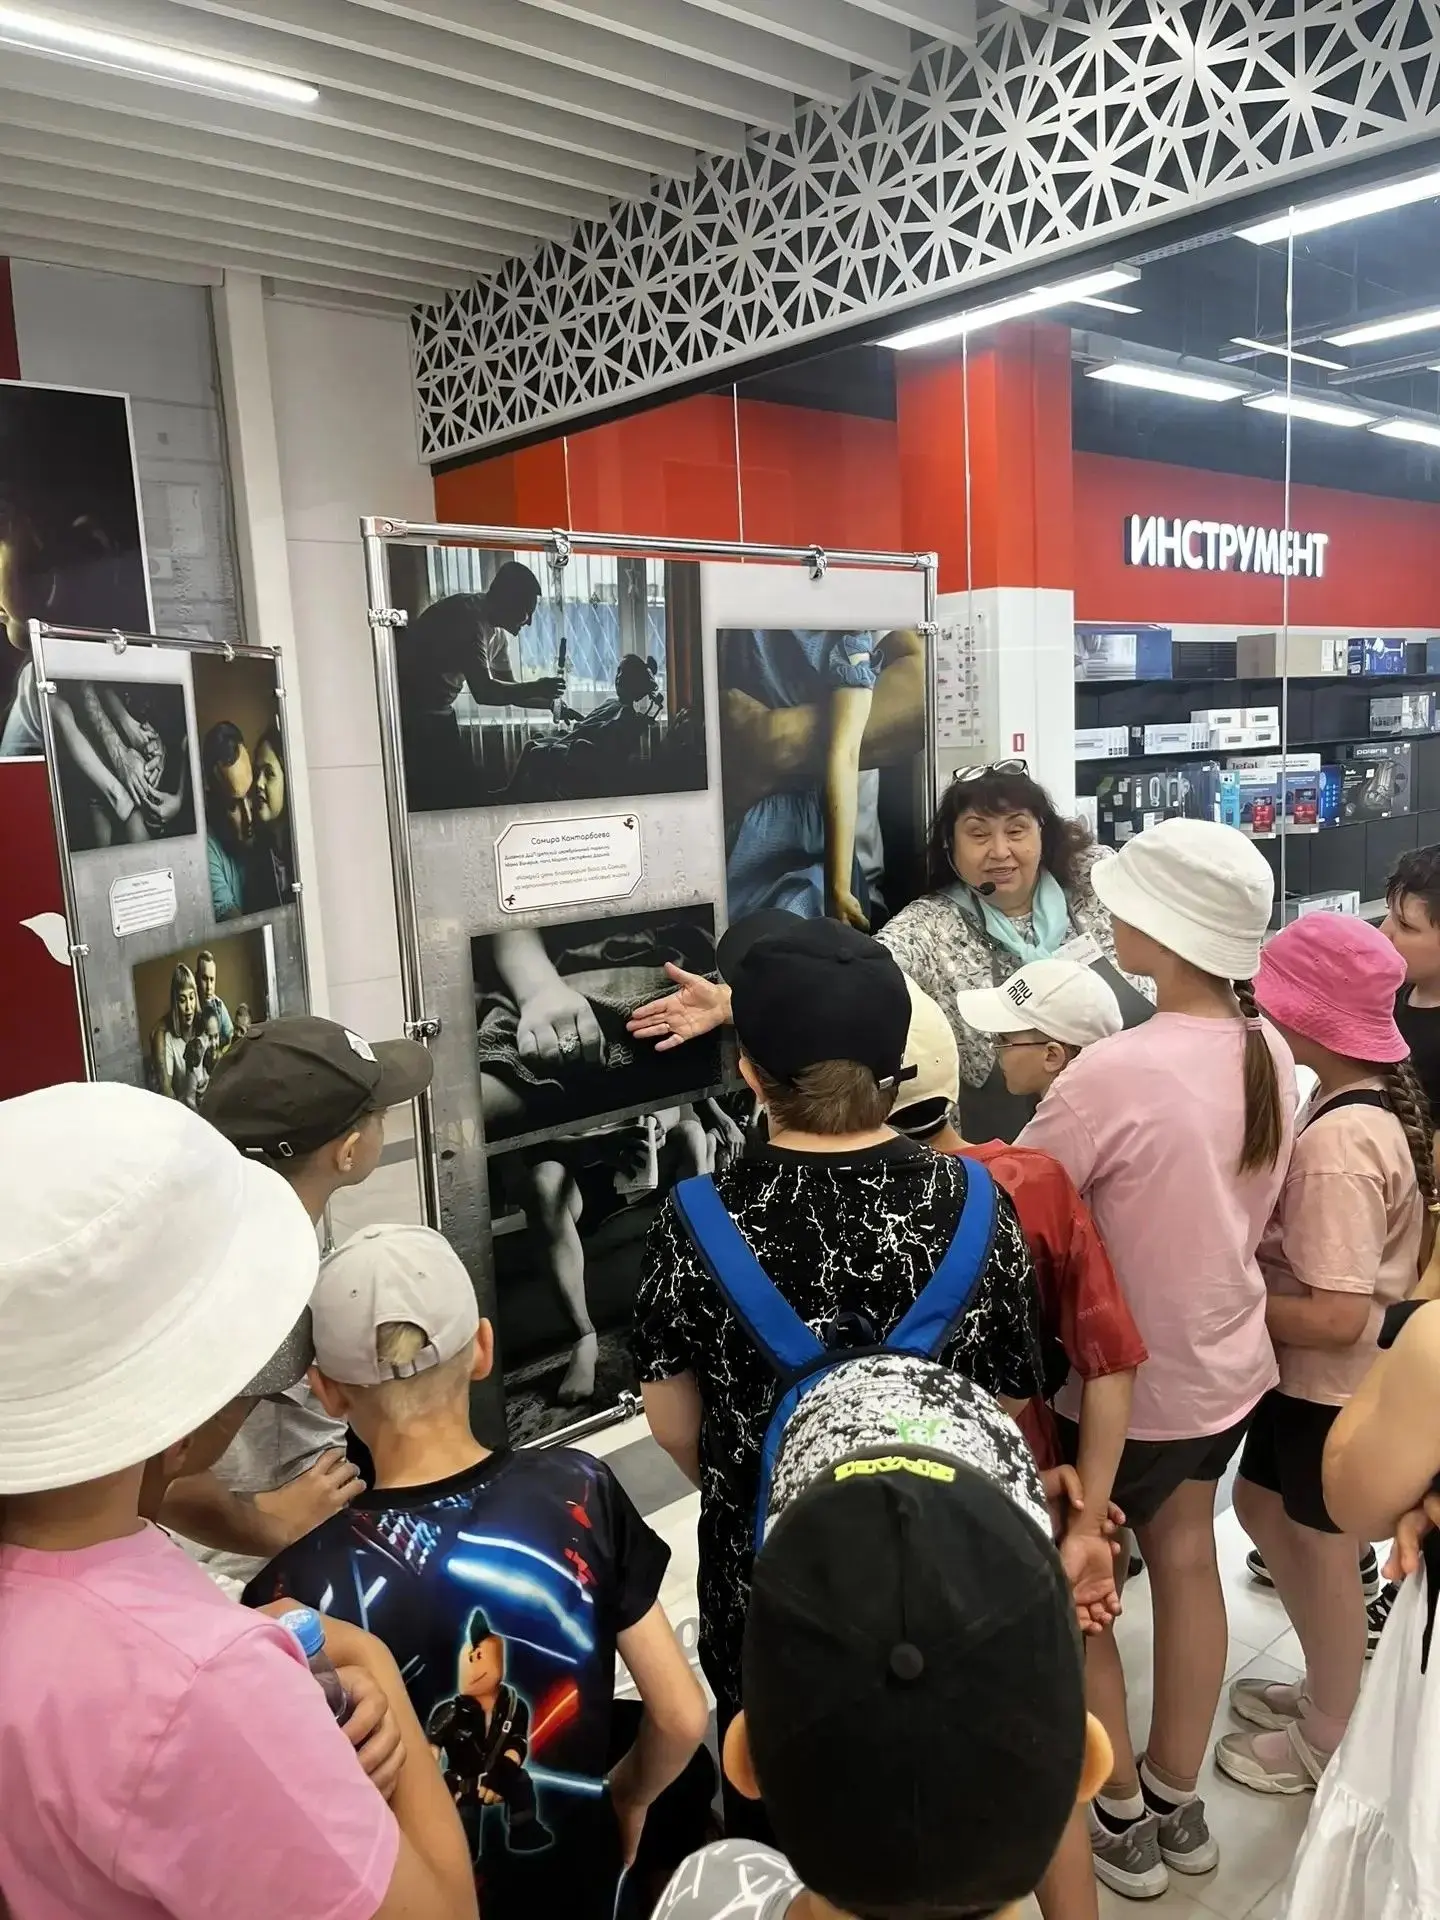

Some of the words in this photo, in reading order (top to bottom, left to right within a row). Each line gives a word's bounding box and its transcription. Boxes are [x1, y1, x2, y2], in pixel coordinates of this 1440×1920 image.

[1129, 513, 1329, 578] ИНСТРУМЕНТ
[1356, 748, 1388, 756] polaris
[531, 837, 560, 845] Самира
